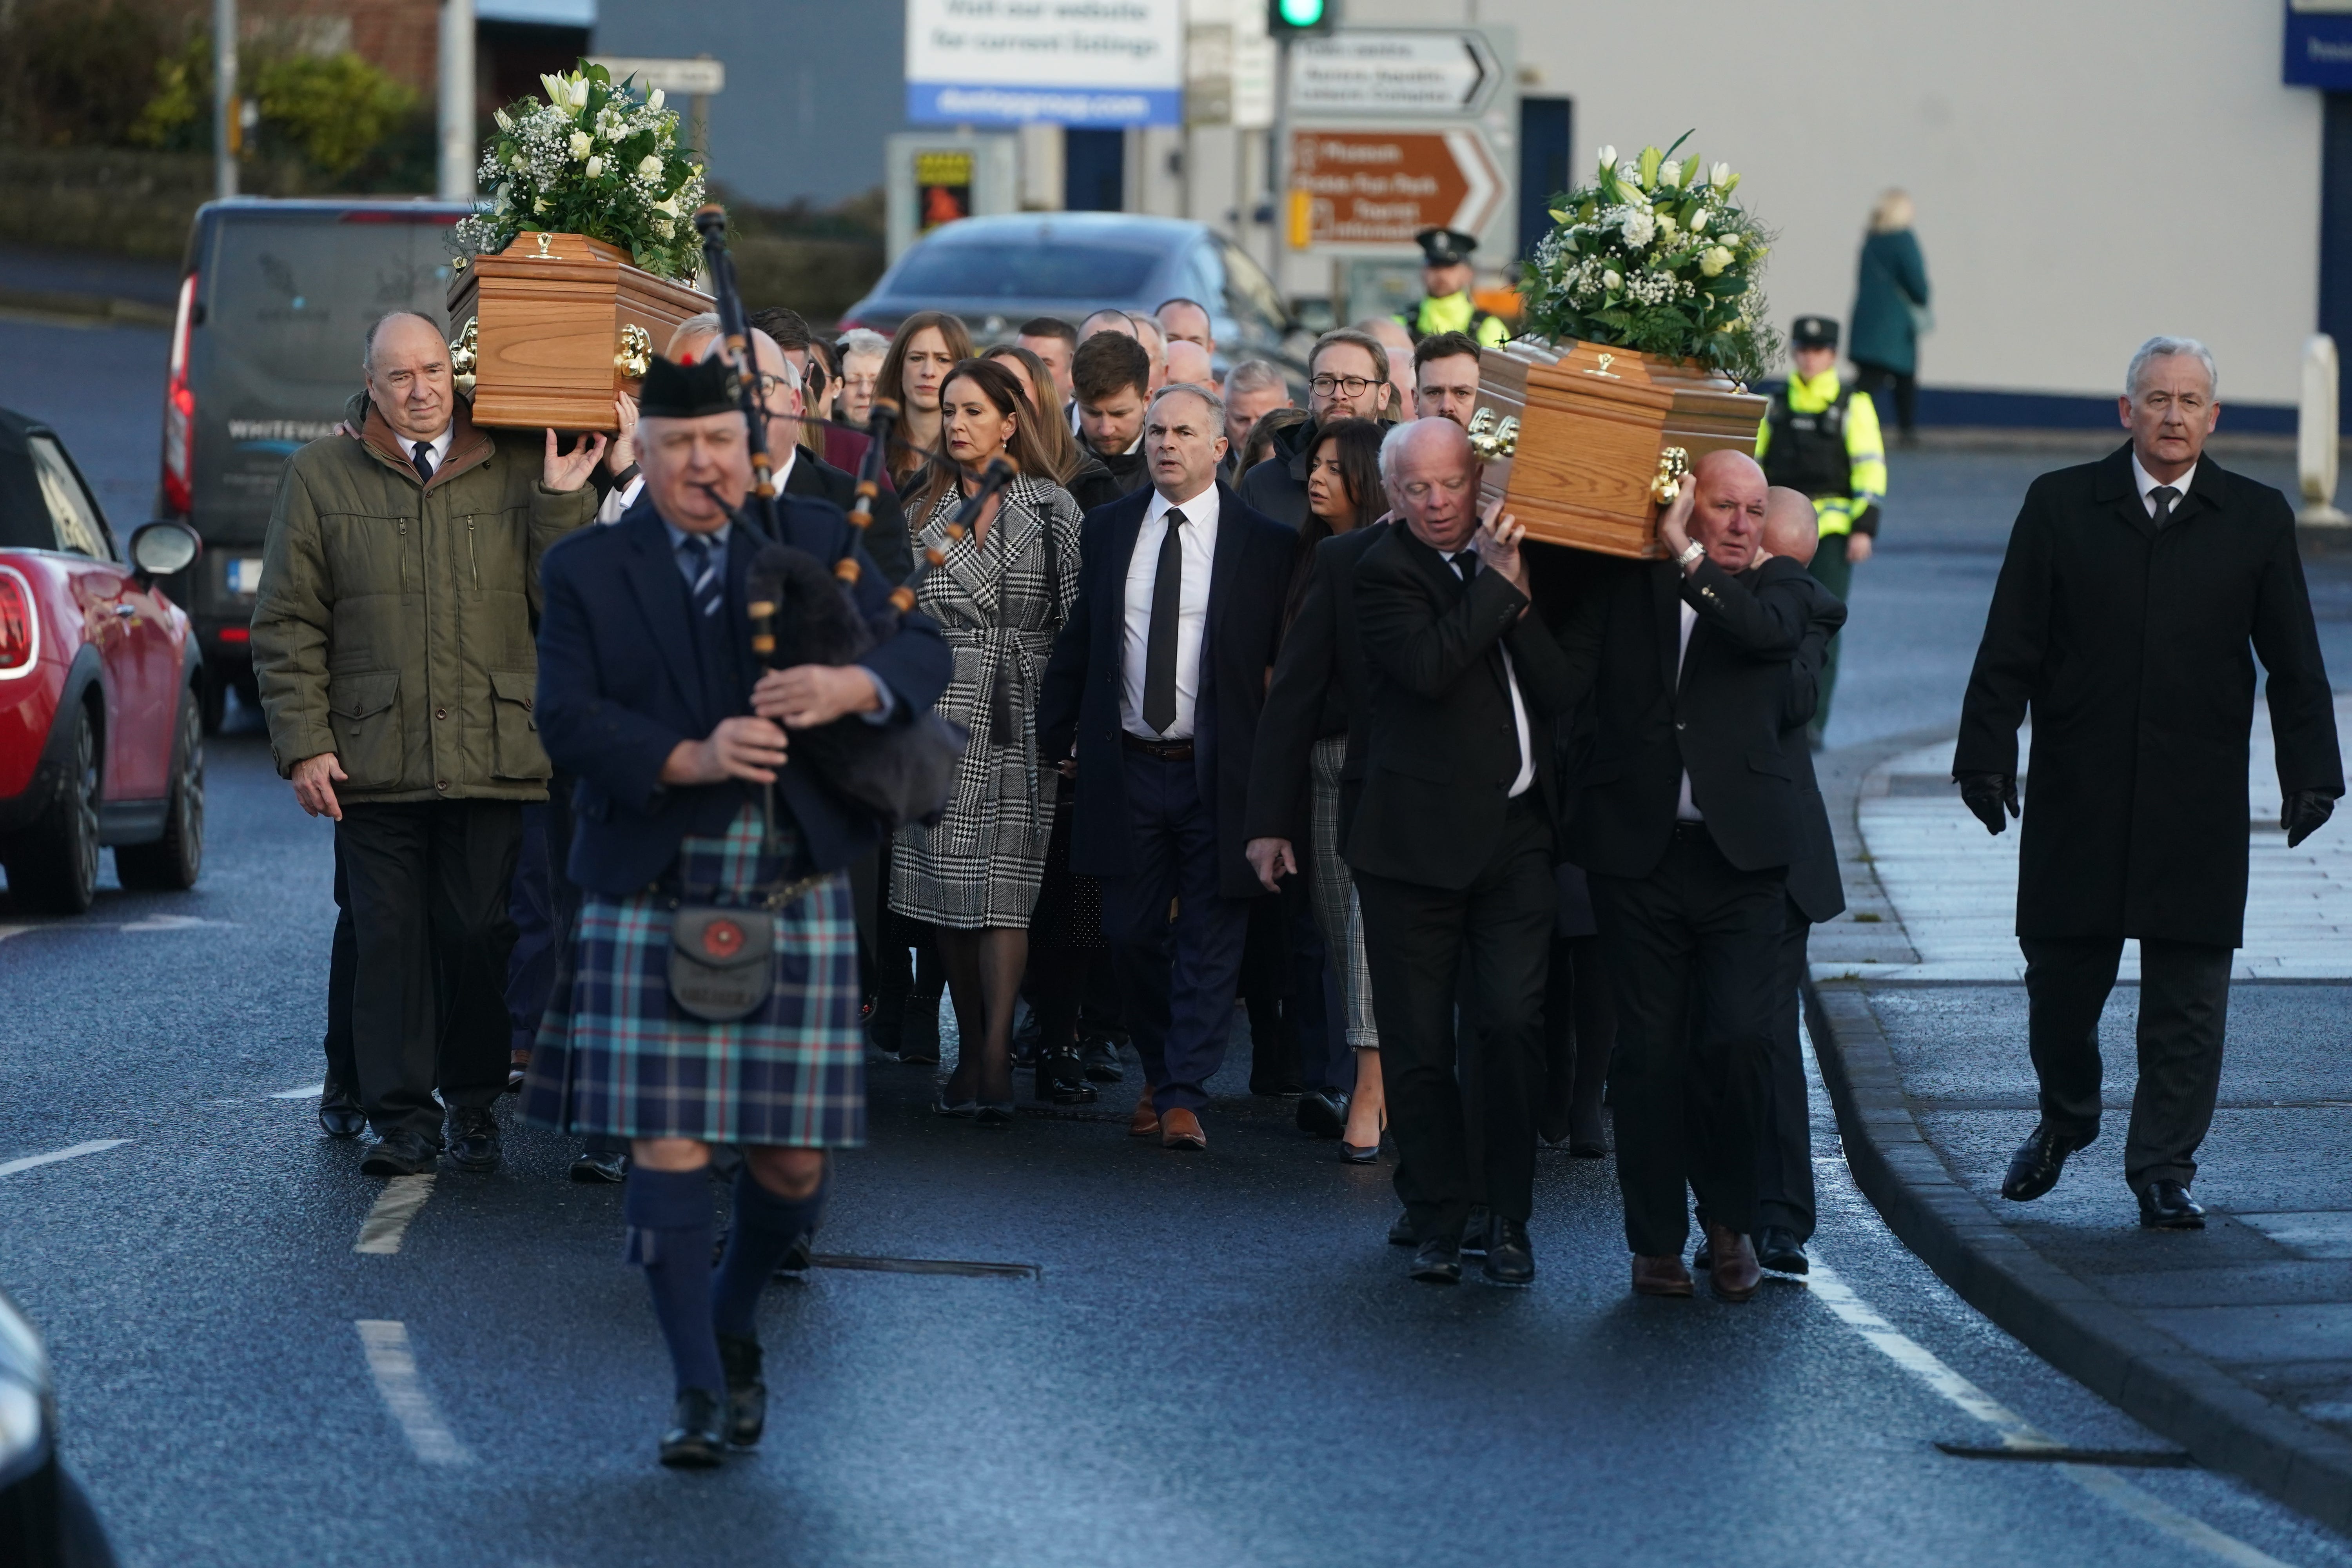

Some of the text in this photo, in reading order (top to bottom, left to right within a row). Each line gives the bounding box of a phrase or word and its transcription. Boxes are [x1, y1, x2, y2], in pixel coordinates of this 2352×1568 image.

[947, 0, 1149, 20] Visit our website
[933, 26, 1160, 60] for current listings
